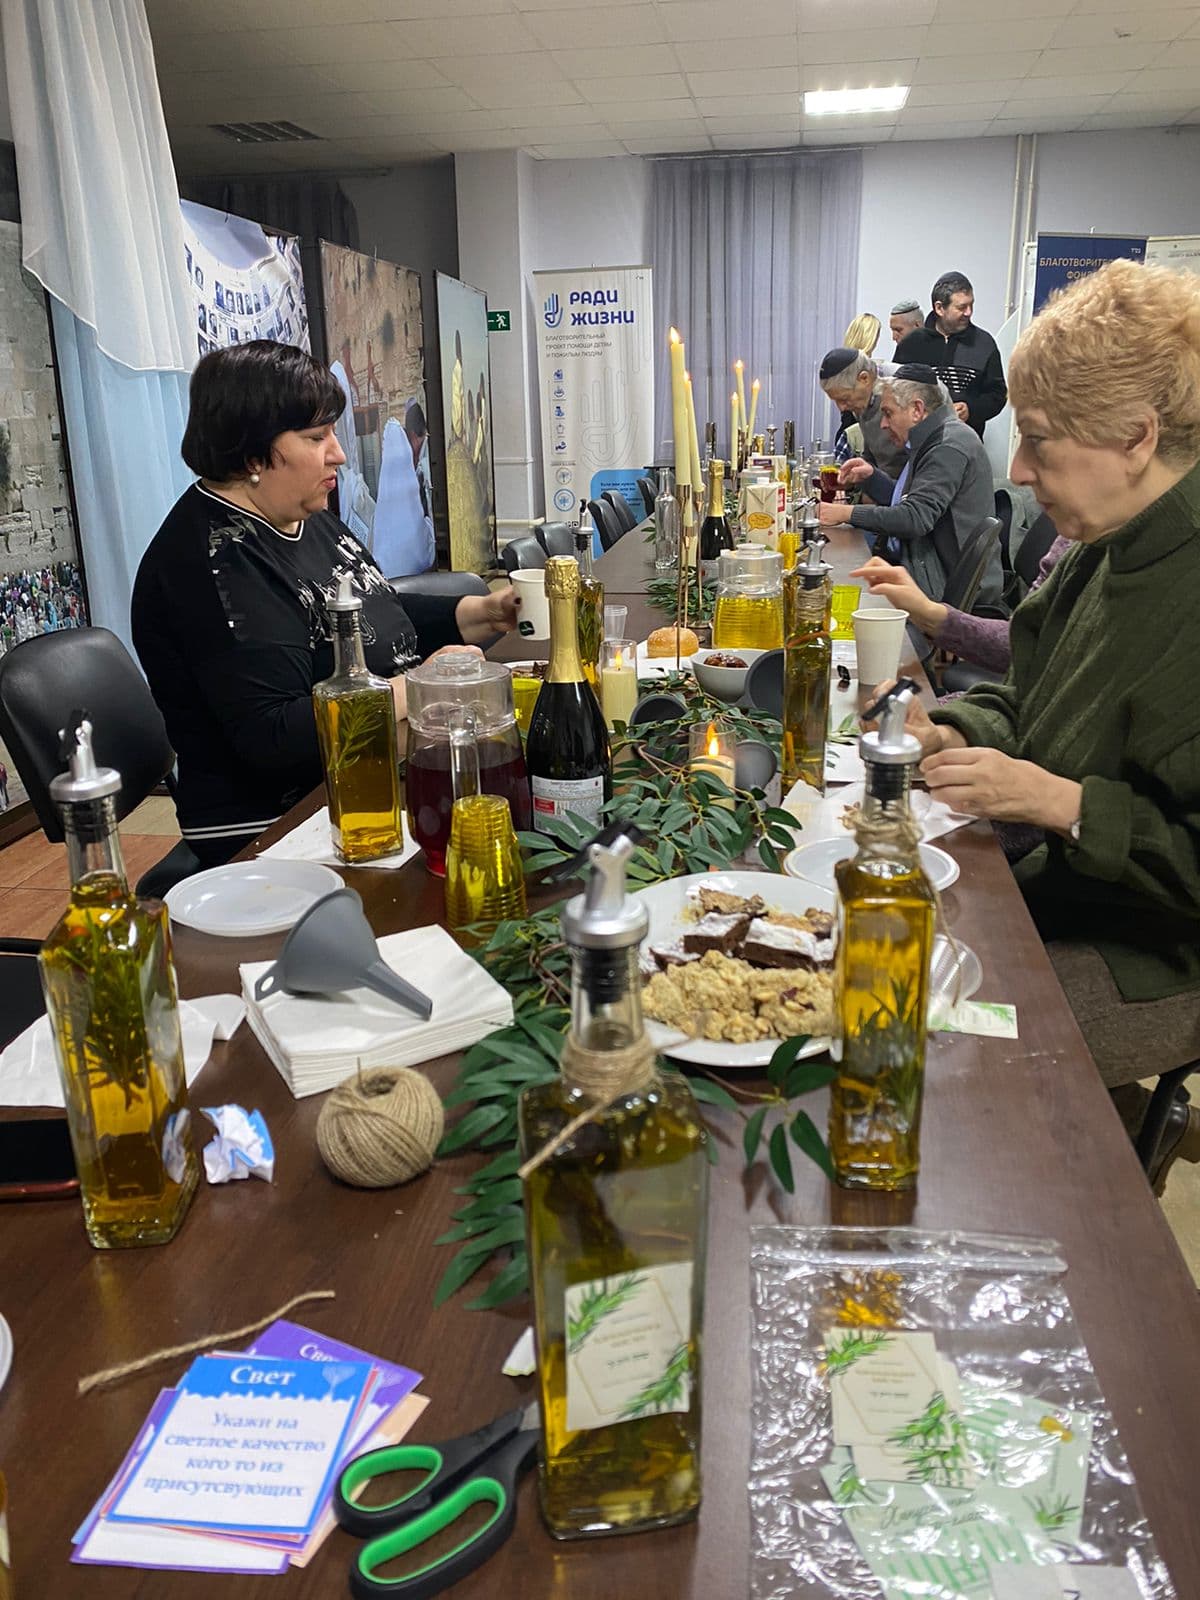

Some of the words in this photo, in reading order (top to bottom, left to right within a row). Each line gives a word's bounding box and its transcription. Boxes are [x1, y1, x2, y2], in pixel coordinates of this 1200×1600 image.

[569, 289, 618, 306] РАДИ
[571, 310, 635, 326] ЖИЗНИ
[545, 333, 606, 341] БЛАГОТВОРИТЕЛЬНЫЙ
[230, 1364, 297, 1386] Свет
[213, 1412, 271, 1428] Укажи
[276, 1418, 298, 1429] на
[164, 1435, 238, 1449] светлое
[241, 1439, 326, 1451] качество
[186, 1457, 230, 1470] кого
[235, 1460, 256, 1471] то
[259, 1461, 284, 1473] из
